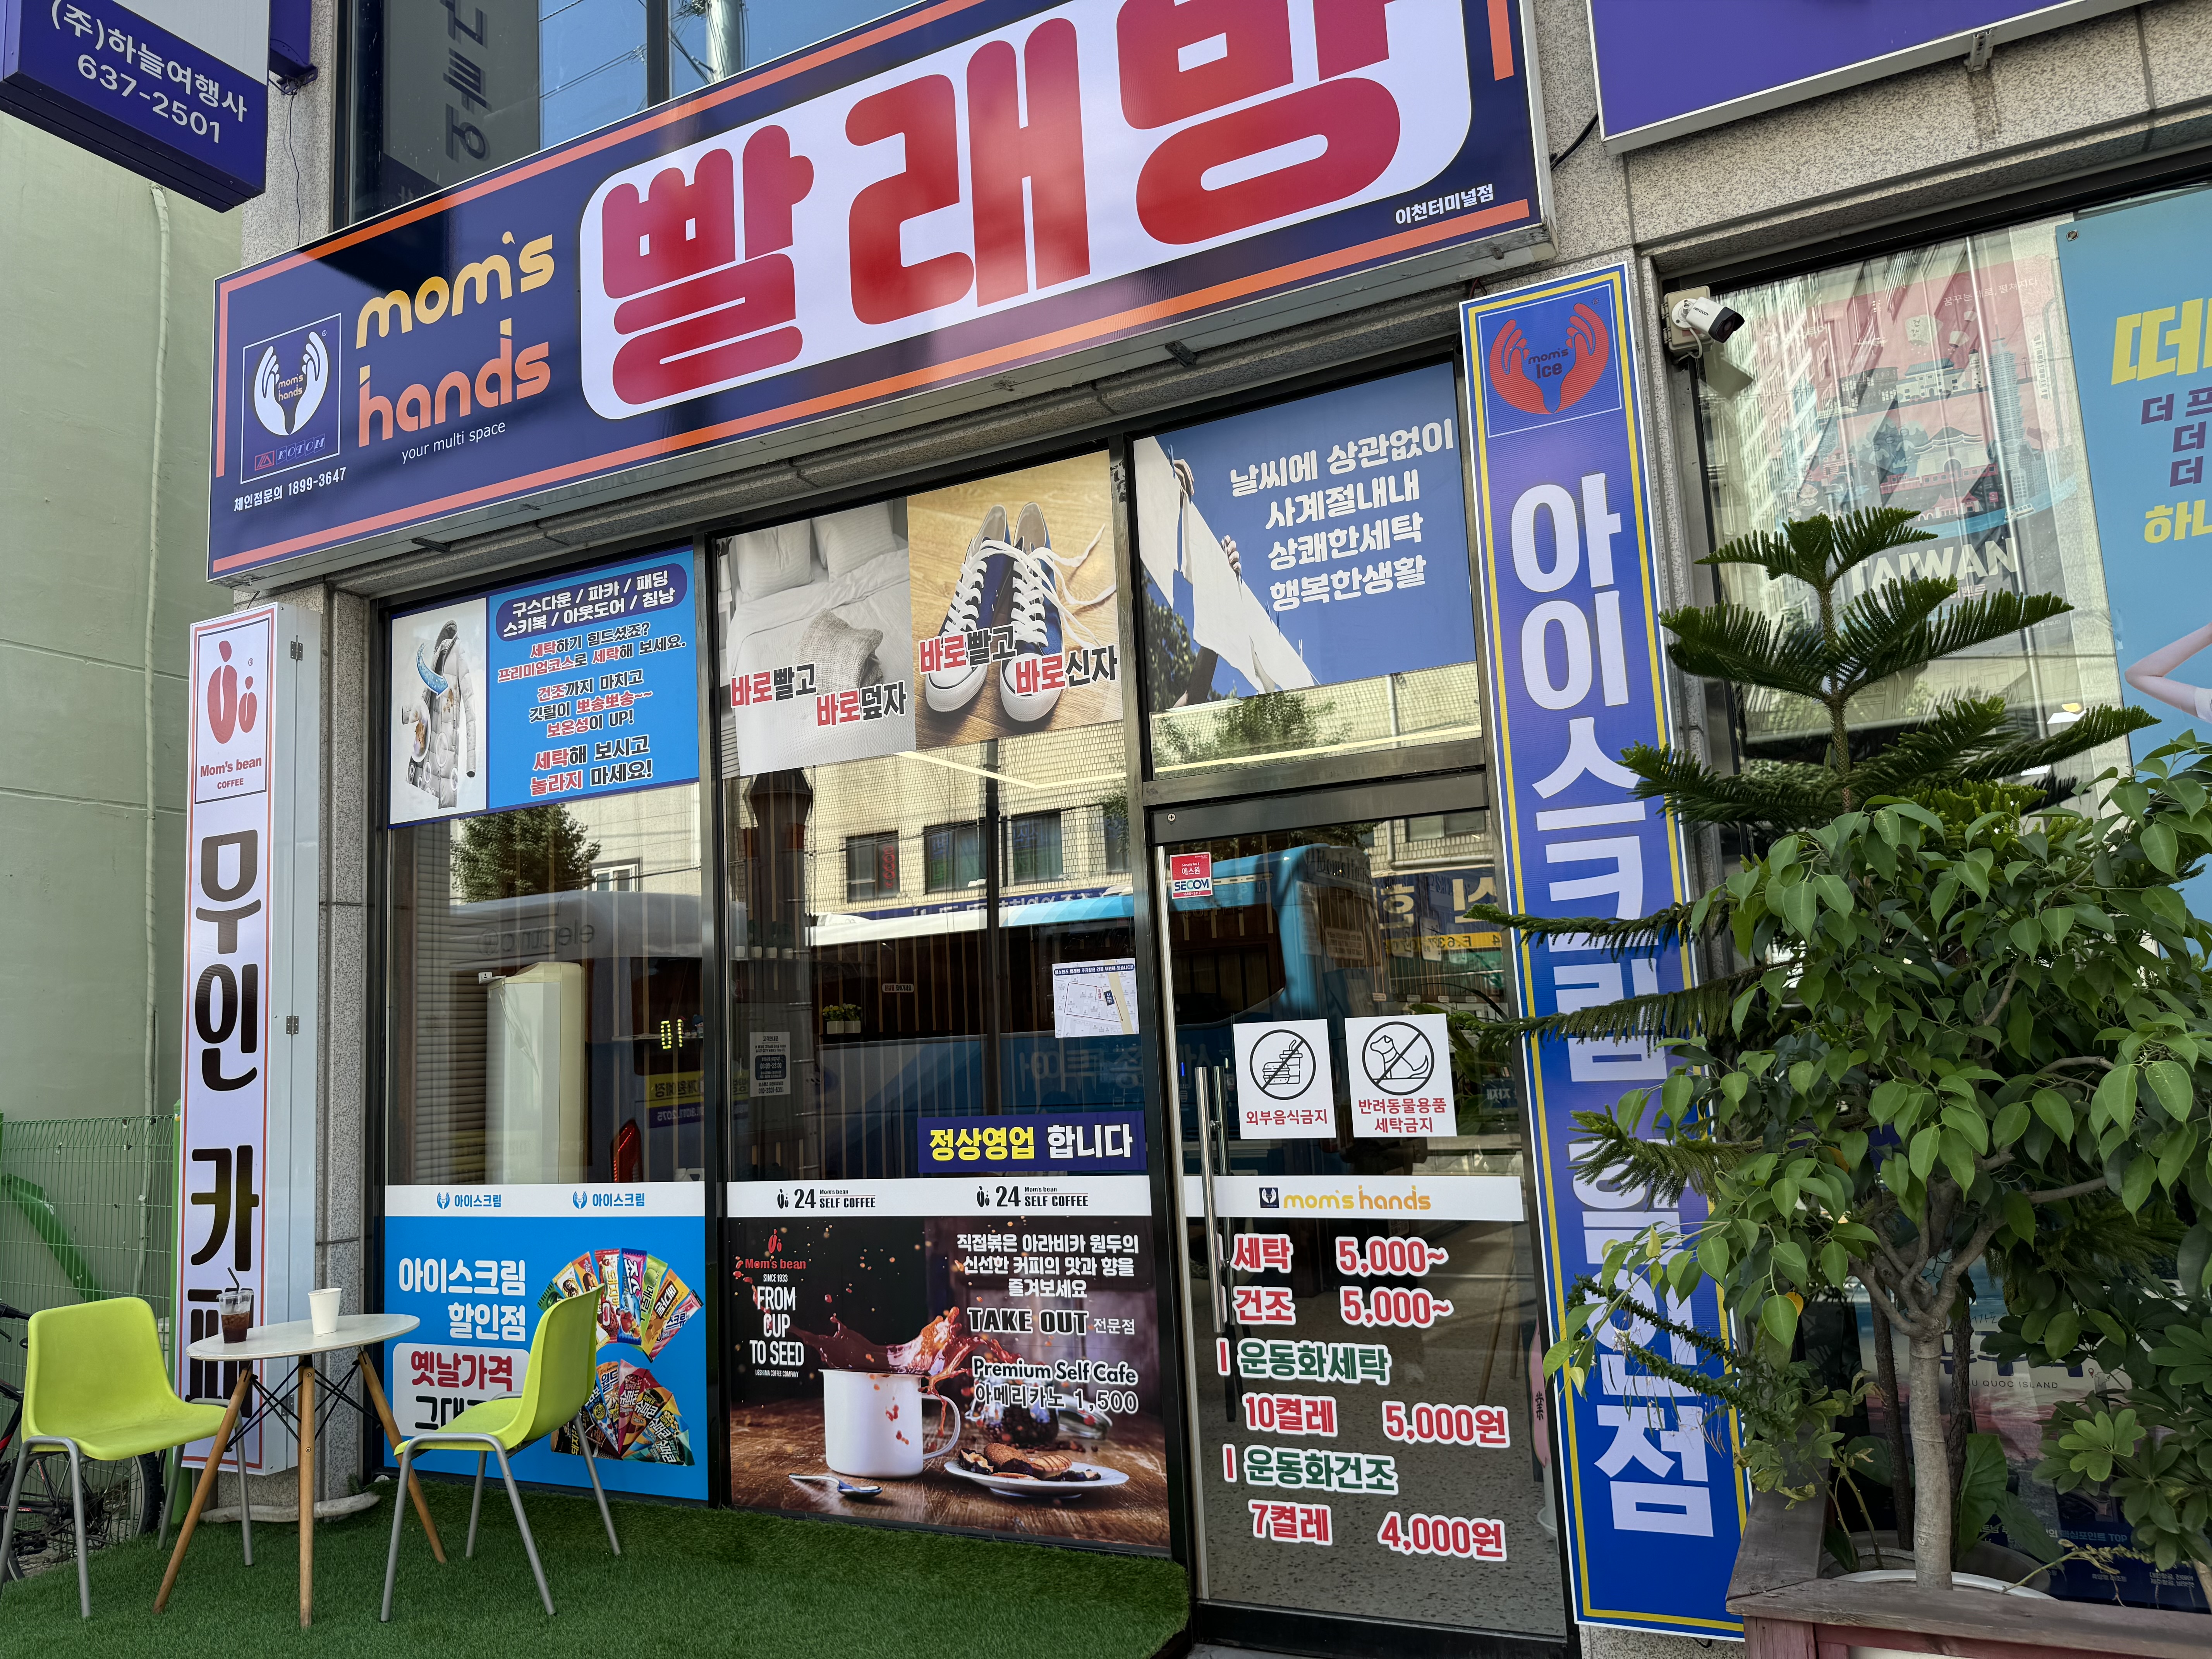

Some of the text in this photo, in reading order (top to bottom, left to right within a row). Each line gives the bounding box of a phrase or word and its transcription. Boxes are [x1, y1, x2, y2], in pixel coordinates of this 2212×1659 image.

[52, 0, 247, 122] (주)하늘여행사
[78, 54, 220, 143] 637-2501
[601, 0, 1401, 405] 빨래방
[1395, 184, 1494, 224] 이천터미널점
[356, 231, 555, 349] mom's
[1943, 293, 1973, 307] 꿈꾸는
[1998, 277, 2039, 294] 펼쳐지다
[1693, 307, 1710, 316] HIKVISION
[1528, 348, 1568, 364] mom's
[1536, 362, 1562, 379] Ice
[278, 374, 303, 389] mom's
[278, 385, 302, 401] hands
[359, 318, 551, 447] hands
[2141, 393, 2174, 425] 더
[277, 436, 325, 460] KOTOM
[402, 422, 505, 464] your multi space
[2172, 421, 2206, 453] 더
[1230, 418, 1454, 497] 날씨에 상관없이
[2170, 456, 2203, 487] 더
[234, 467, 346, 512] 체인점문의 1899-3647
[1265, 469, 1420, 530] 사계절내내
[1268, 511, 1424, 571] 상쾌한세탁
[1850, 537, 2020, 596] TAIWAN
[512, 570, 668, 618] 구스다운 파카 패딩
[1269, 554, 1427, 612] 행복한생활
[503, 587, 675, 638] 스키복 아웃도어 침낭
[530, 622, 650, 659] 세탁하기 힘드셨죠?
[919, 624, 1017, 675] 바로빨고
[498, 634, 687, 683] 프리미엄코스로 세탁해 보세요.
[1015, 644, 1118, 696] 바로신자
[538, 668, 644, 702] 건조까지 마치고
[730, 662, 818, 709] 바로빨고
[576, 690, 653, 715] 뽀송뽀송~~
[816, 680, 907, 728] 바로덮자
[546, 709, 634, 738] 보온성이 UP!
[200, 757, 262, 777] Mom's bean
[532, 735, 650, 771] 세탁해 보시고
[217, 778, 244, 790] COFFEE
[530, 759, 653, 797] 놀라지 마세요!
[1511, 471, 1667, 1083] 아이스크림
[1174, 879, 1209, 891] SECOM
[1182, 866, 1200, 875] 에스원
[194, 829, 262, 1092] 무인
[1245, 1108, 1328, 1126] 외부음식금지
[1358, 1097, 1447, 1115] 반려동물용품
[1374, 1116, 1433, 1133] 세탁금지
[929, 1124, 1133, 1161] 정상영업 합니다
[454, 1194, 502, 1208] 아이스크림
[592, 1192, 646, 1207] 아이스크림
[794, 1188, 816, 1209] 24
[819, 1197, 876, 1208] SELF COFFEE
[995, 1185, 1022, 1207] 24
[1024, 1195, 1089, 1207] SELF COFFEE
[1283, 1185, 1431, 1210] mom's hands
[957, 1234, 1139, 1254] 직접볶은 아라비카 원두의
[1232, 1235, 1447, 1275] 세탁 5,000~
[398, 1257, 526, 1297] 아이스크림
[745, 1258, 806, 1269] Mom's bean
[763, 1274, 788, 1283] SINCE 1933
[963, 1255, 1135, 1277] 신선한 커피의 맛과 향을
[757, 1286, 796, 1311] FROM
[1008, 1278, 1088, 1298] 즐겨보세요
[448, 1301, 526, 1342] 할인점
[967, 1307, 1135, 1336] TAKE OUT 전문점
[1235, 1288, 1451, 1325] 건조 5,000~
[763, 1313, 790, 1338] CUP
[749, 1340, 804, 1366] TO SEED
[1239, 1340, 1389, 1382] 운동화세탁
[410, 1350, 513, 1392] 옛날가격
[782, 1370, 799, 1378] COMPANY
[972, 1355, 1139, 1386] Premium Self Cafe
[415, 1395, 489, 1431] 그대
[634, 1400, 659, 1420] 슈퍼콘
[975, 1383, 1139, 1415] 아메리카노 1,500
[1244, 1395, 1508, 1445] 10켤레 5,000원
[1246, 1448, 1396, 1492] 운동화건조
[1250, 1503, 1505, 1558] 7켤레 4,000원
[2108, 1533, 2128, 1543] TOP
